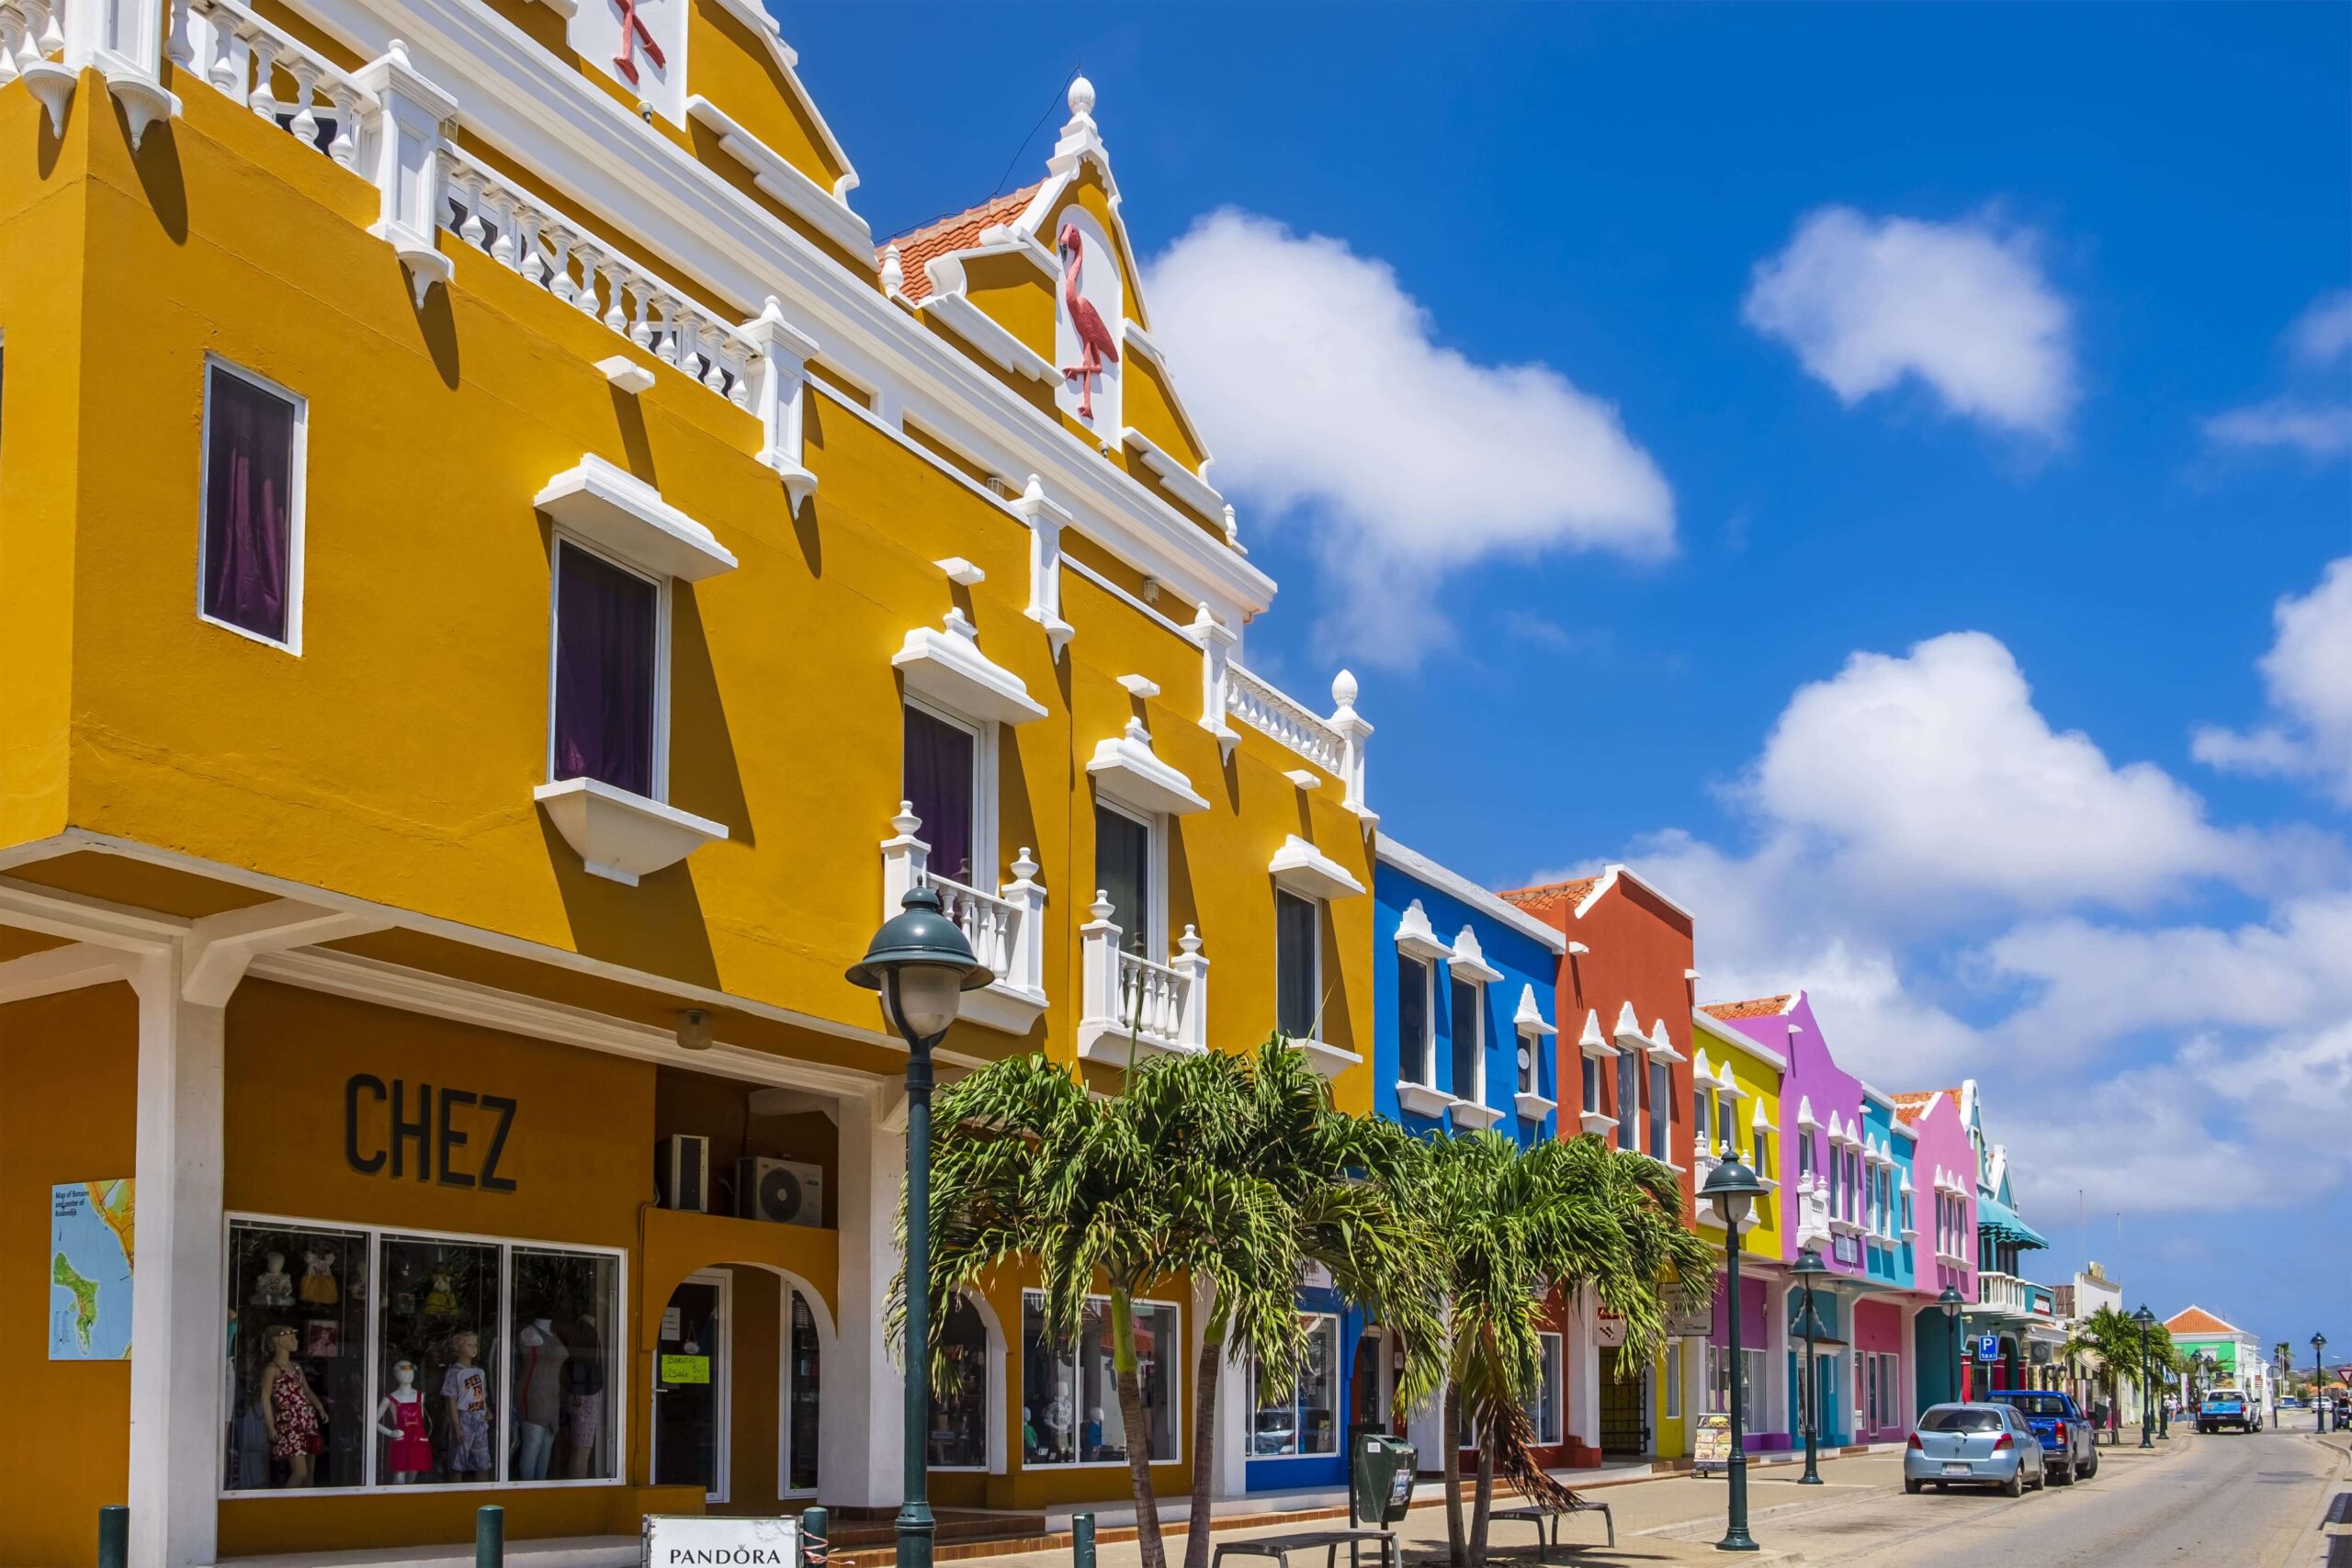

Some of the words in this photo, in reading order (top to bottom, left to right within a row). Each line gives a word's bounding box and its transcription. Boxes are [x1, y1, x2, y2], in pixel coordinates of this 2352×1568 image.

[346, 1074, 517, 1192] CHEZ
[1983, 1337, 1994, 1350] P
[670, 1544, 781, 1564] PANDORA
